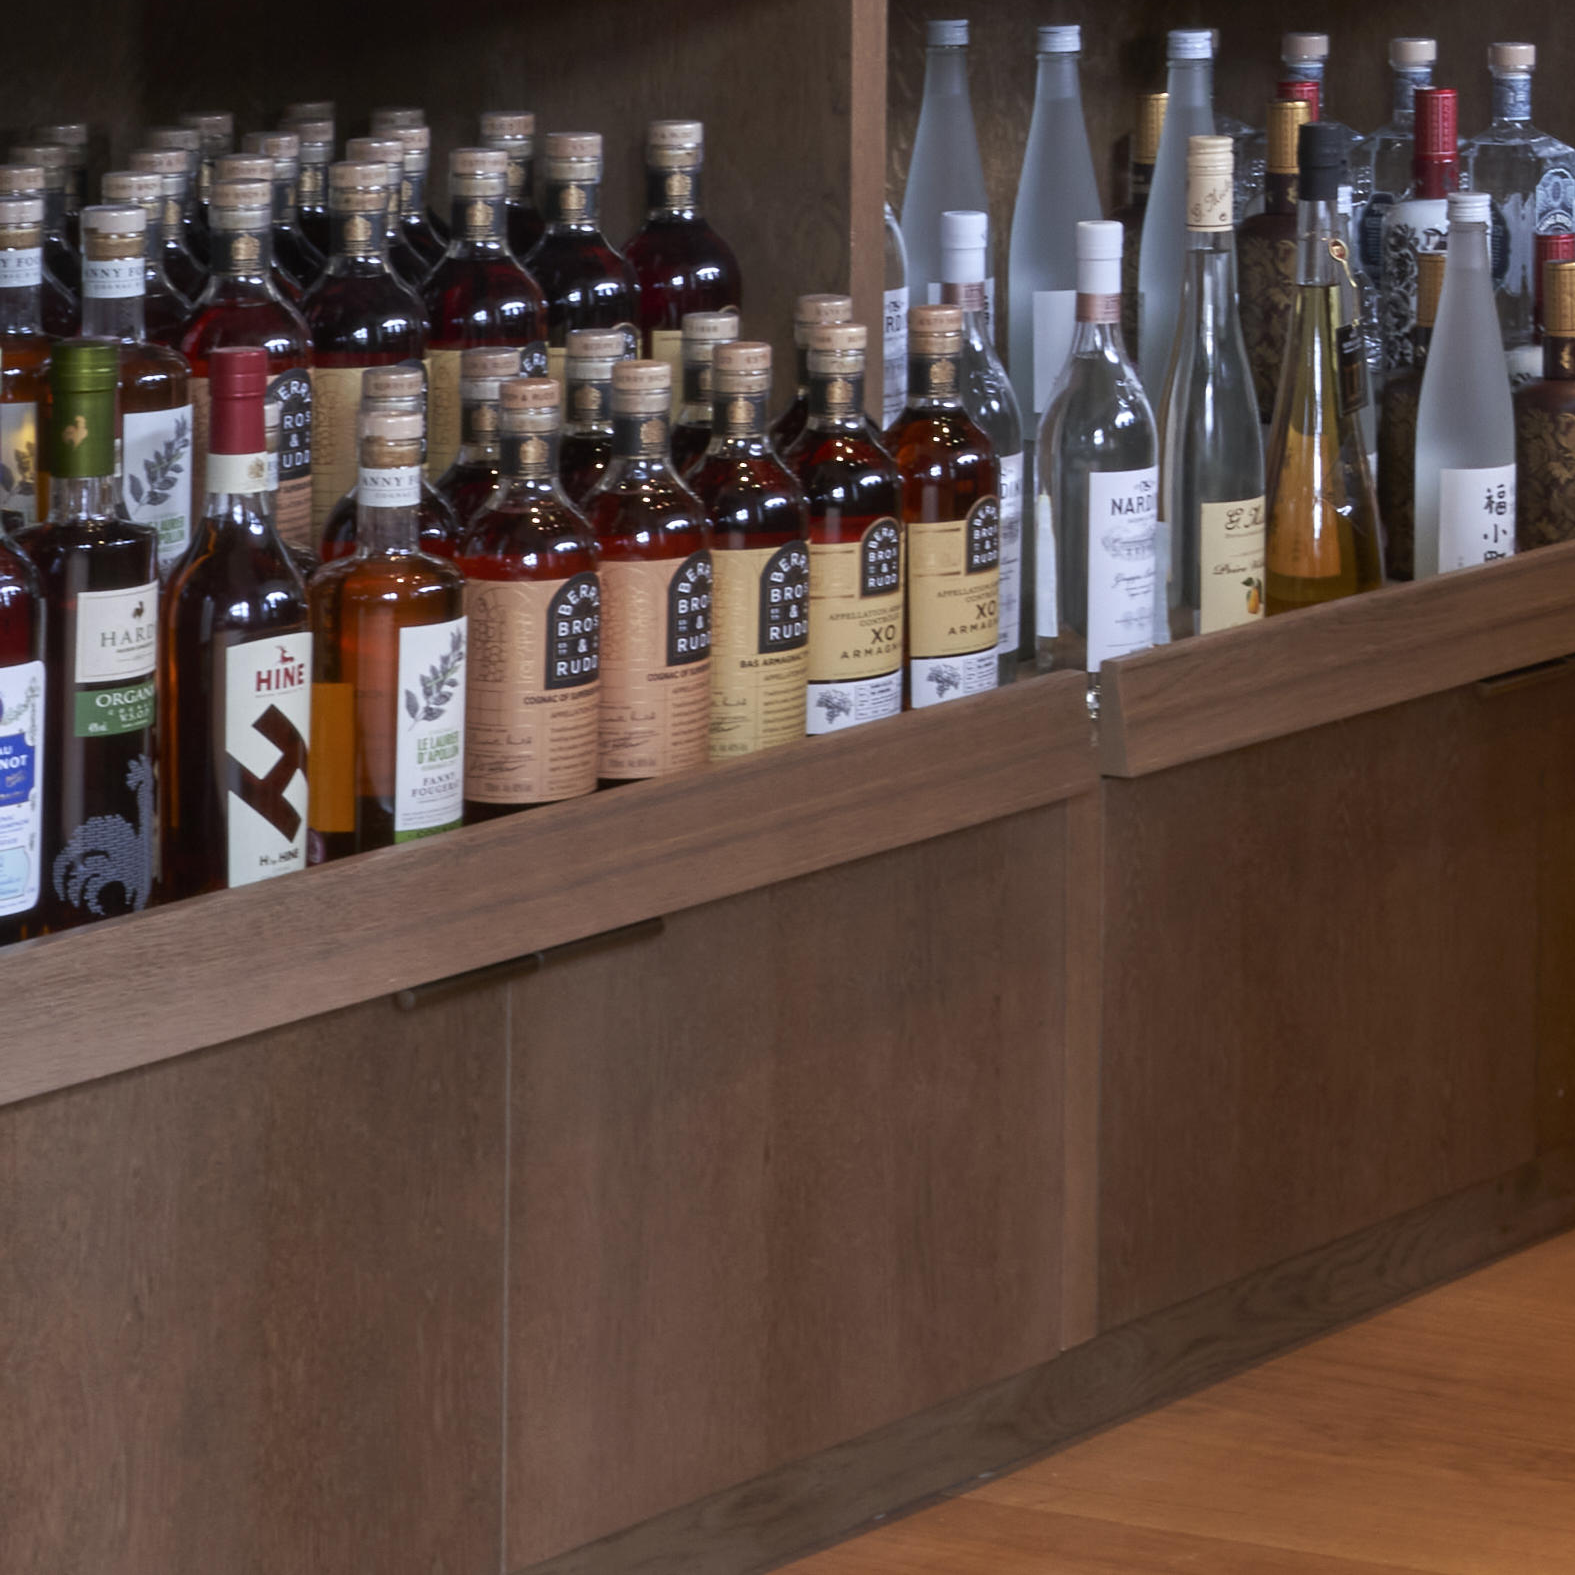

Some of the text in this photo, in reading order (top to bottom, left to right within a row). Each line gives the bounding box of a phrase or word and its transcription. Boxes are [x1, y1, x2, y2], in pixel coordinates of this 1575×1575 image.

[276, 380, 312, 403] ERRY
[283, 411, 311, 429] ROS
[289, 433, 299, 447] &
[282, 449, 310, 468] UDD
[984, 540, 991, 550] &
[881, 563, 888, 573] &
[868, 574, 897, 588] RUDD
[789, 604, 798, 618] &
[975, 600, 996, 620] XO
[695, 615, 704, 629] &
[769, 620, 808, 641] RUDD
[870, 624, 896, 644] XO
[577, 639, 588, 652] &
[556, 655, 598, 676] RUDD
[740, 658, 759, 669] BAS
[255, 663, 305, 693] HINE
[278, 847, 300, 864] HINE
